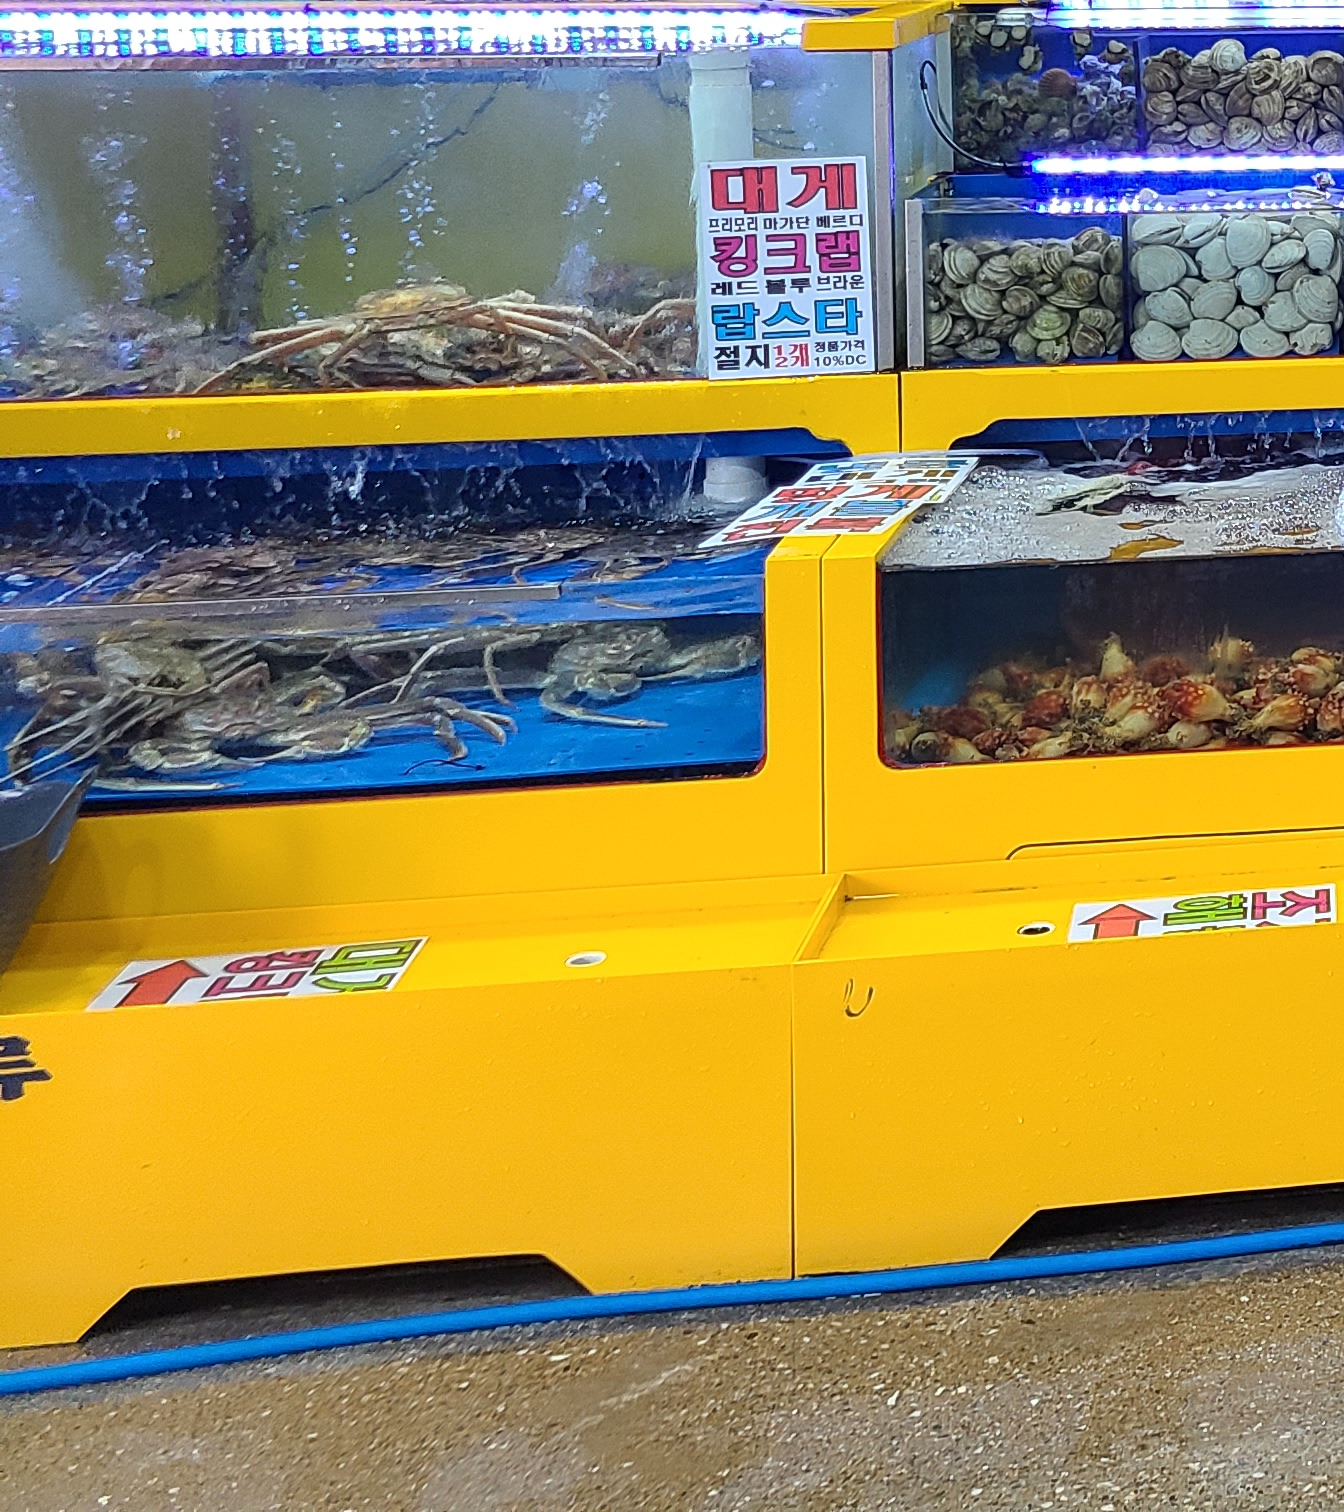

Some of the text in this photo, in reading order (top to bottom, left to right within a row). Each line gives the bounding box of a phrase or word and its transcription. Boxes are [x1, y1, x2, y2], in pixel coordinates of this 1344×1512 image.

[710, 163, 858, 214] 대게
[708, 214, 863, 233] 프리모리 마가단 베르디
[710, 230, 861, 278] 킹크랩
[710, 275, 864, 296] 레드 블루 브라운
[711, 297, 862, 341] 랍스타
[714, 344, 770, 371] 절지
[814, 355, 866, 367] 10%DC
